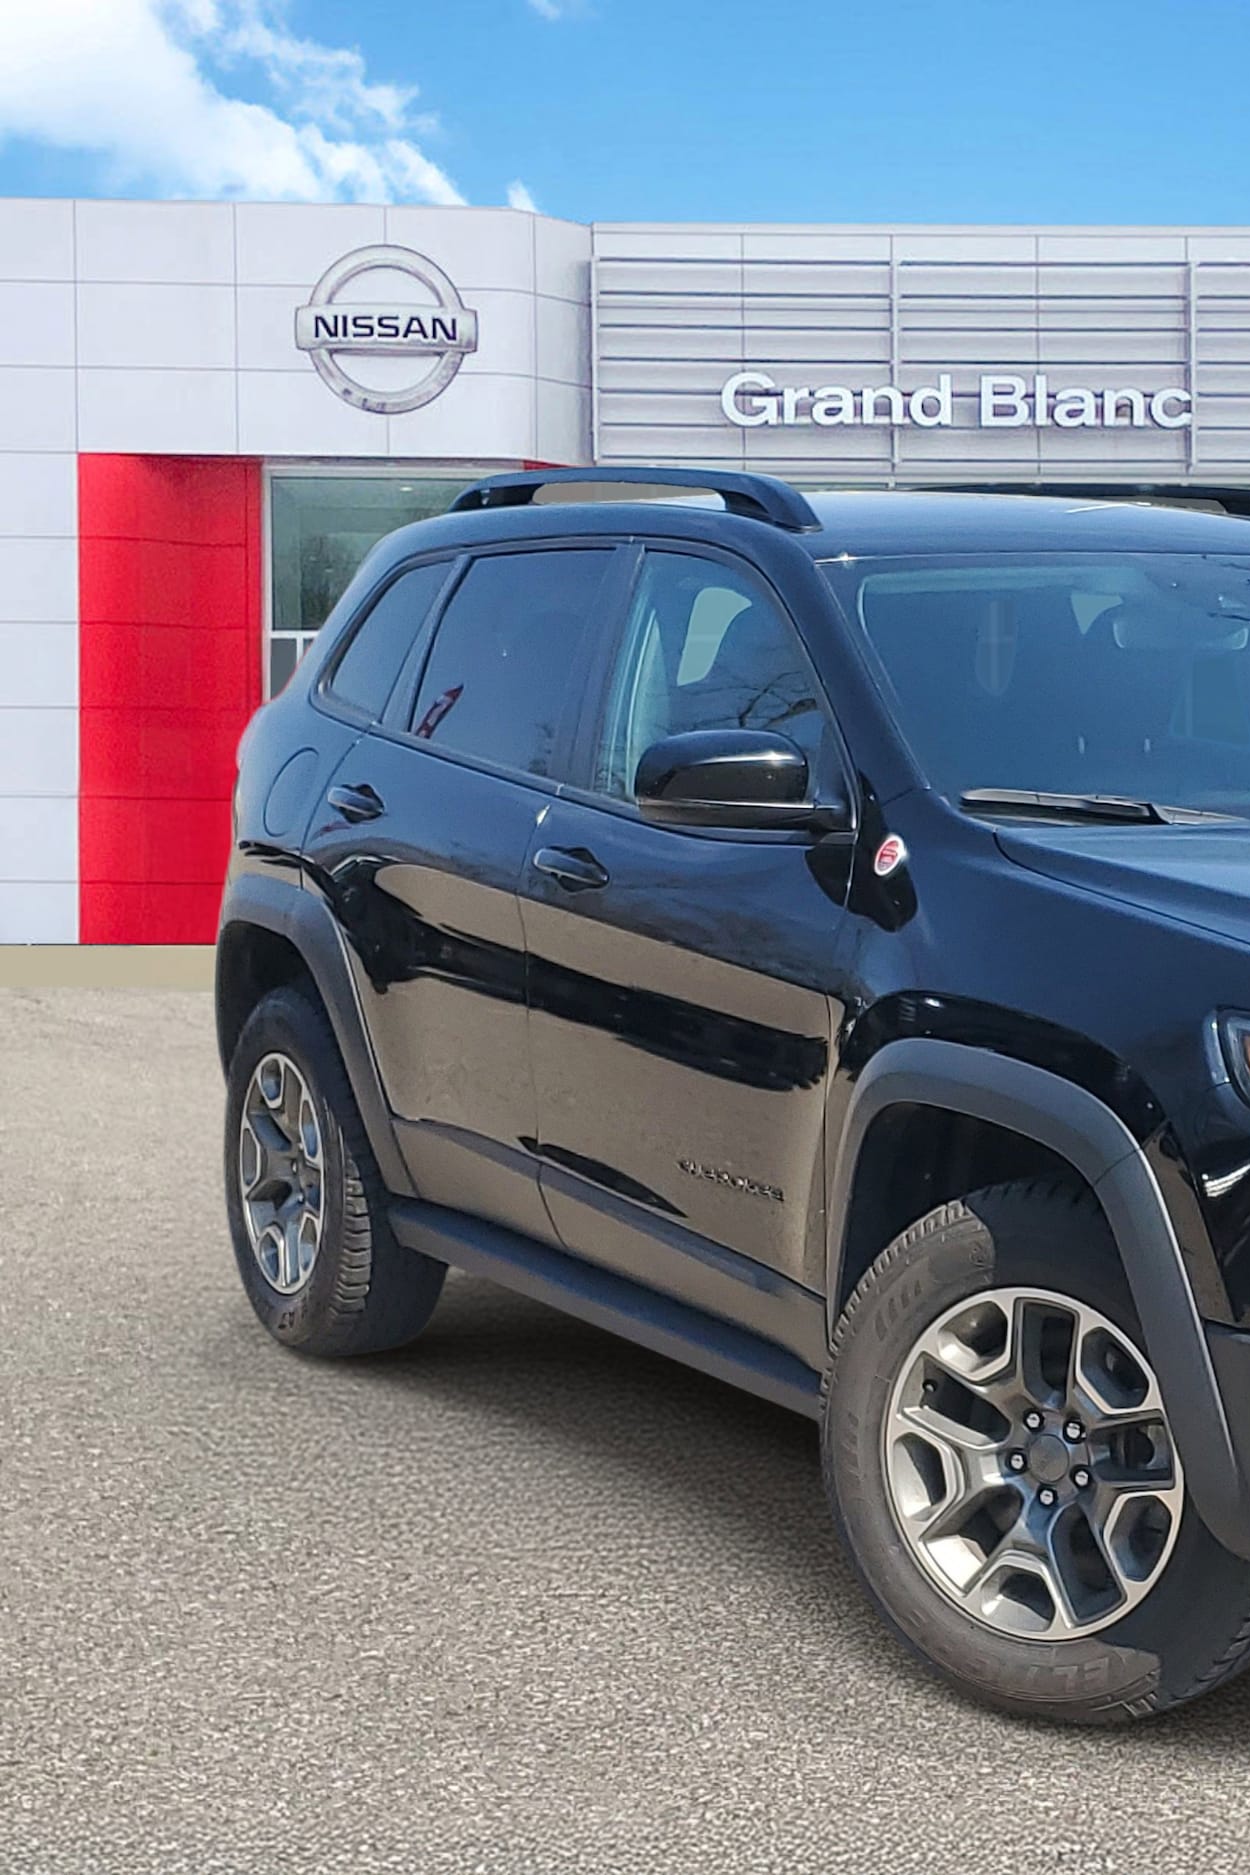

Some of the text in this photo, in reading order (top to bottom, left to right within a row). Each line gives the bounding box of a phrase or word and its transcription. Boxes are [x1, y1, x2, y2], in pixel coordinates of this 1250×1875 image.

[314, 314, 457, 341] NISSAN
[720, 372, 1193, 429] Grand Blanc
